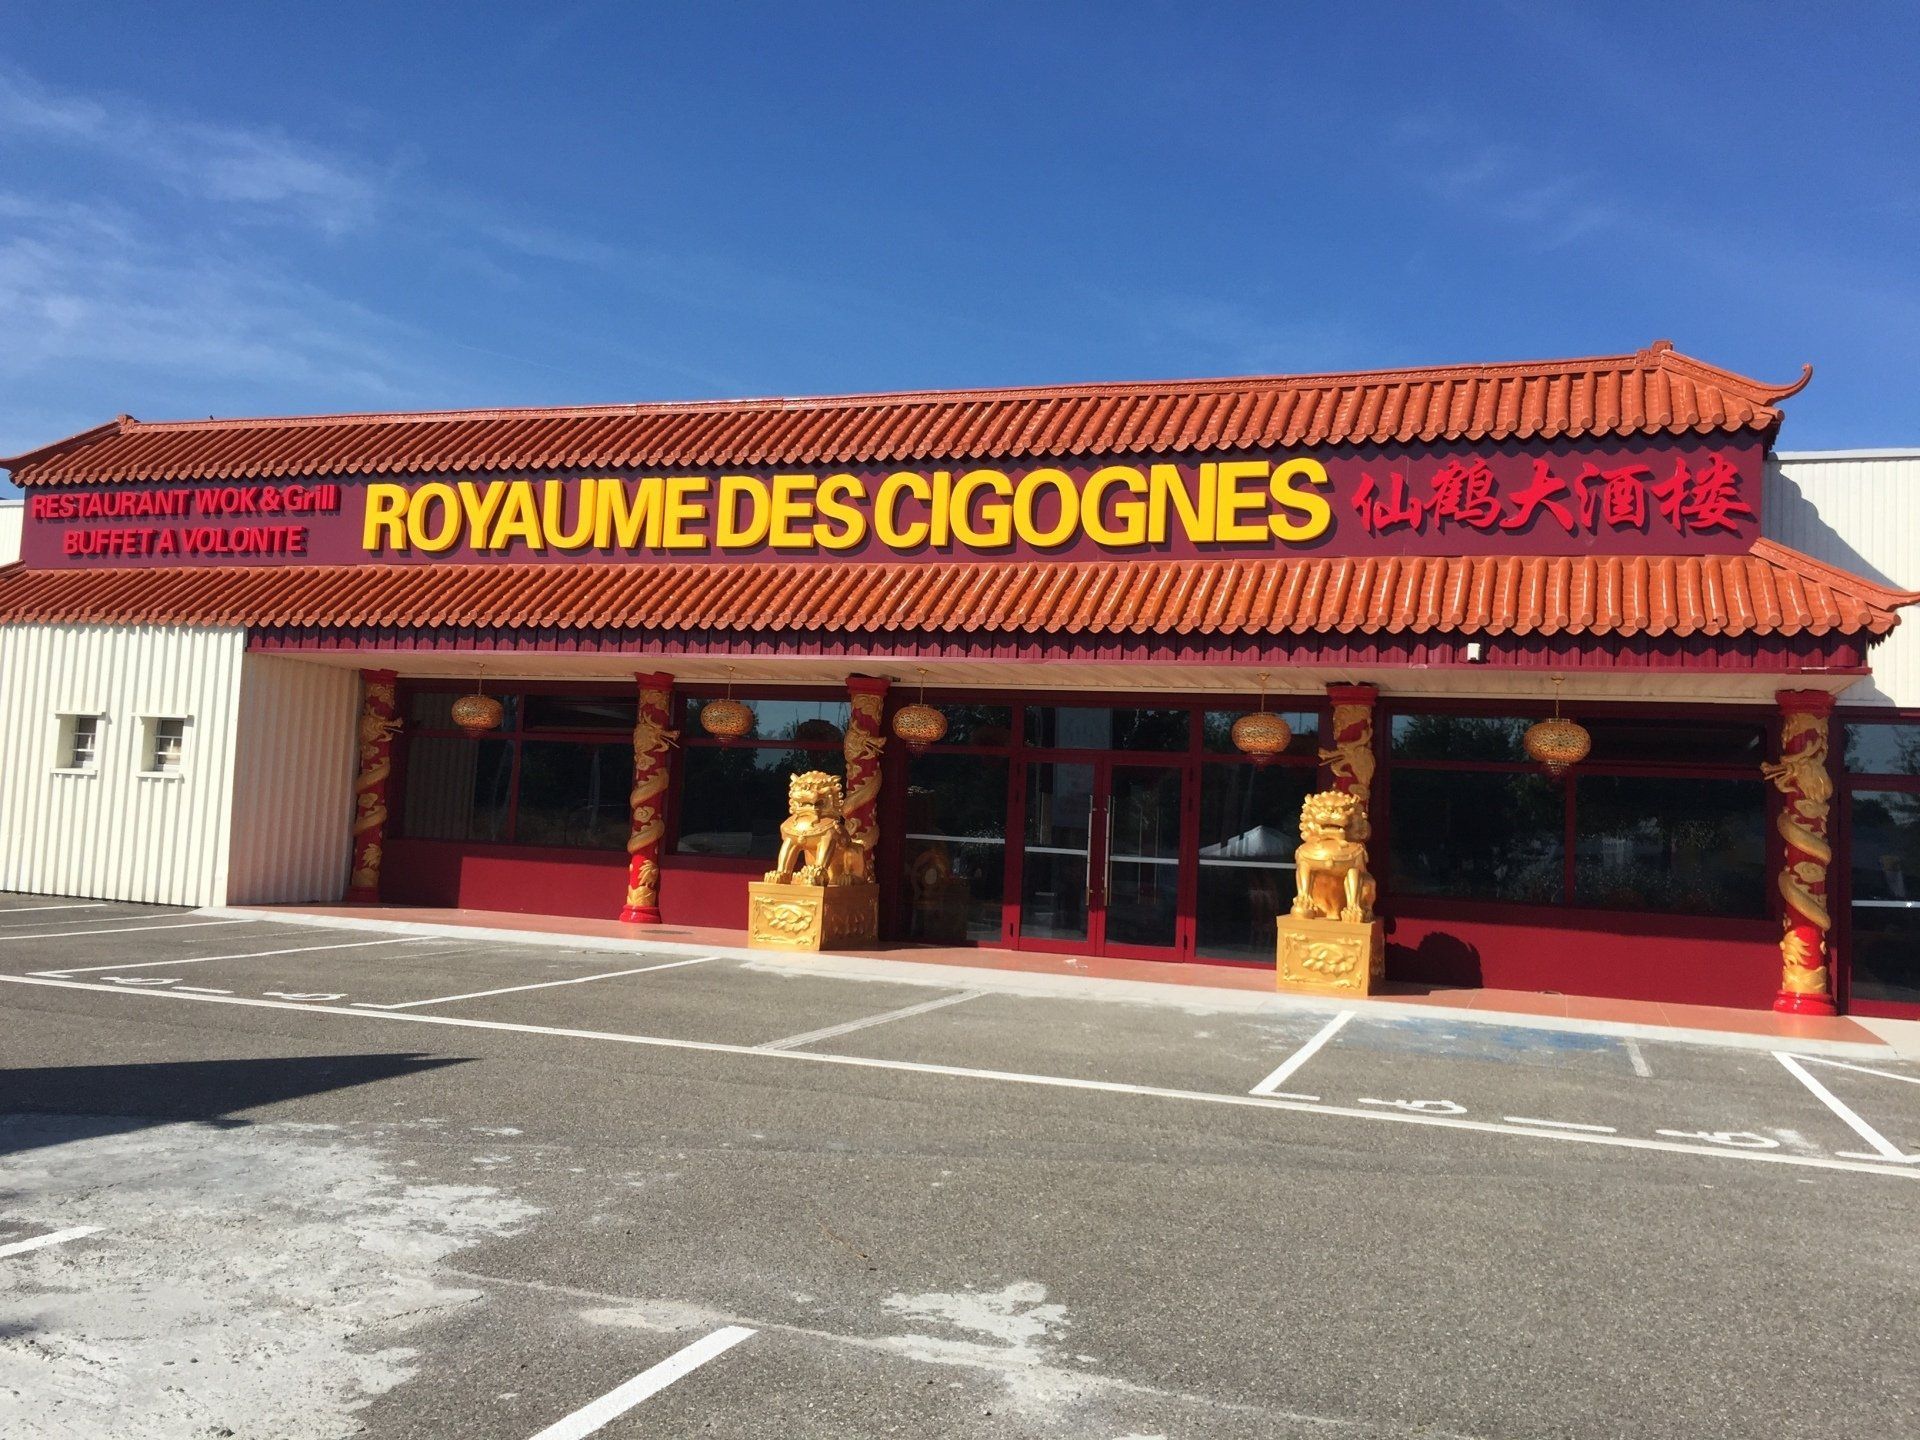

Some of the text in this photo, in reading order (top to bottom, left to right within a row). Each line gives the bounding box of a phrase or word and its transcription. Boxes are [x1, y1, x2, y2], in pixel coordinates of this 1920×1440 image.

[31, 488, 192, 519] RESTAURANT
[362, 457, 1333, 552] ROYAUME DES CIGOGNES
[63, 526, 307, 555] BUFFET A VOLONTE
